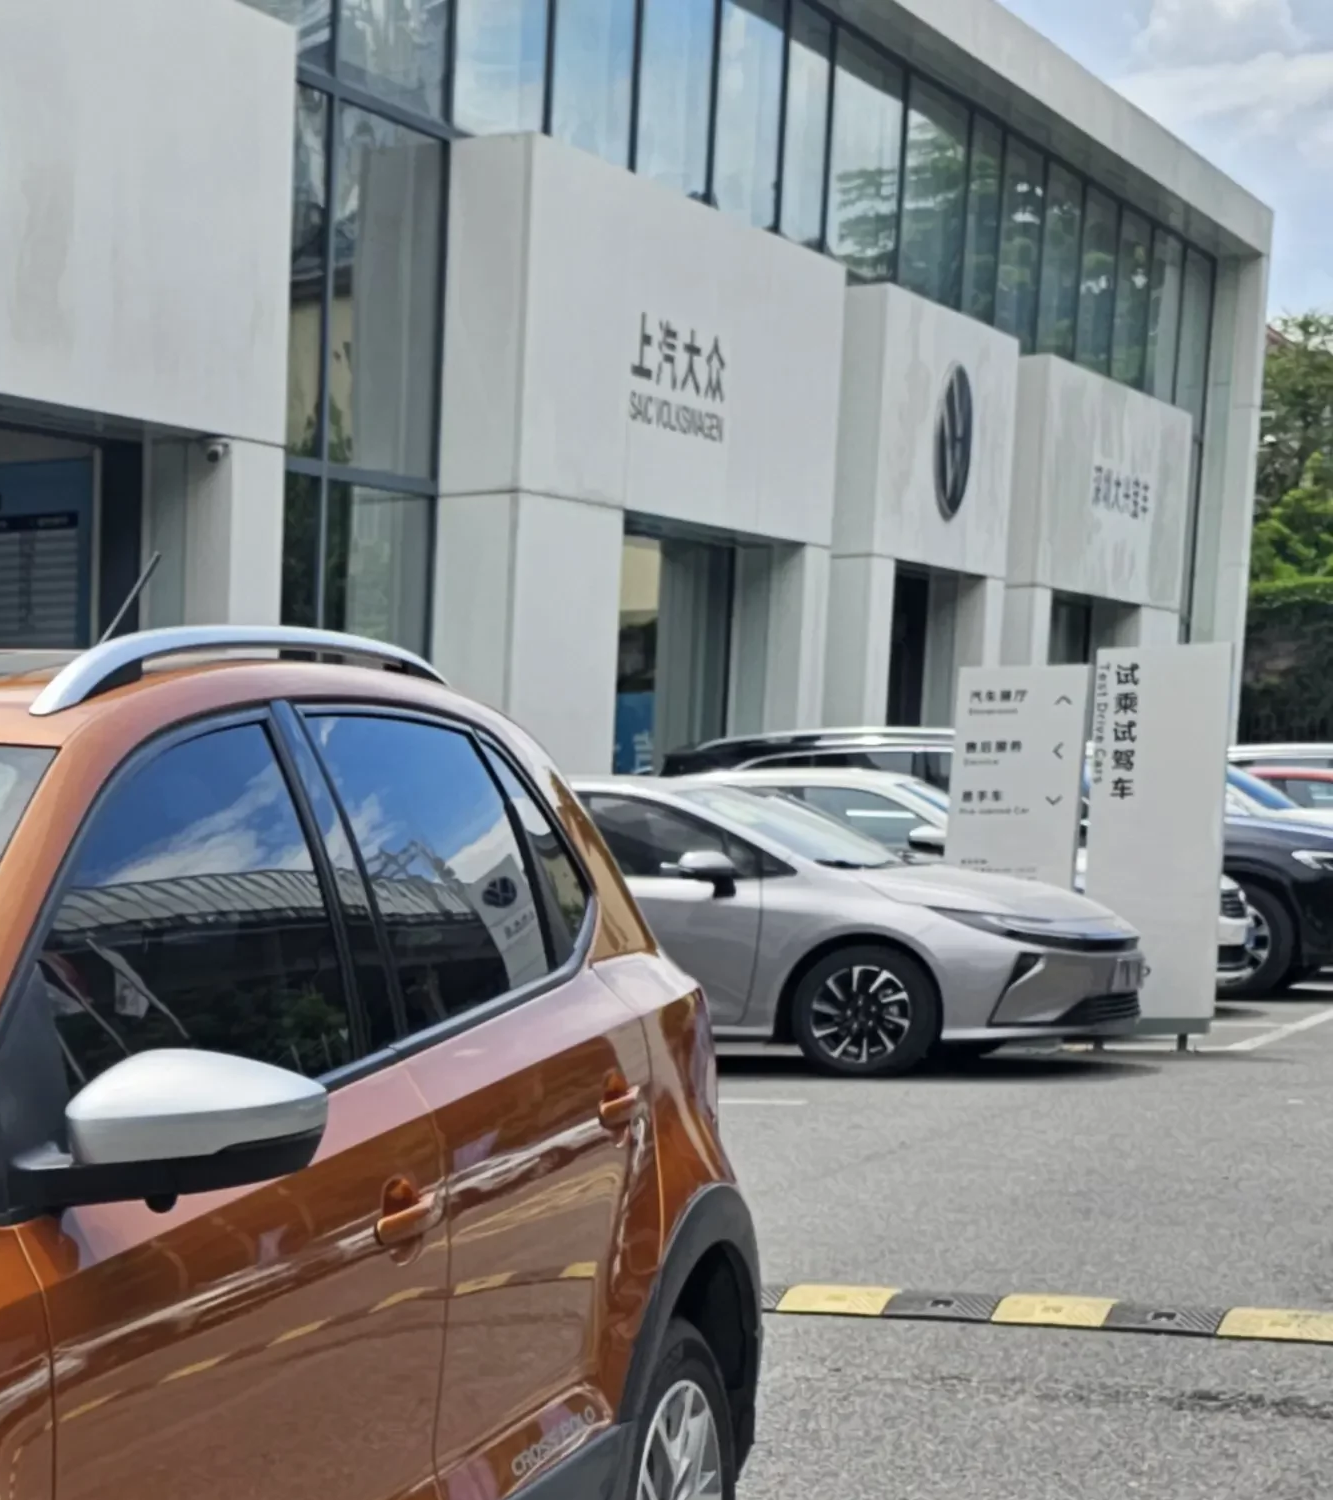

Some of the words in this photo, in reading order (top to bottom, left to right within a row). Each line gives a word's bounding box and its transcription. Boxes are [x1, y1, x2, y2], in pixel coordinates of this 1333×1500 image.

[631, 311, 726, 404] 上汽大众
[1096, 662, 1111, 697] Test
[1094, 702, 1108, 743] Drive
[1110, 662, 1140, 801] 试乘试驾车
[1093, 749, 1107, 785] Cars
